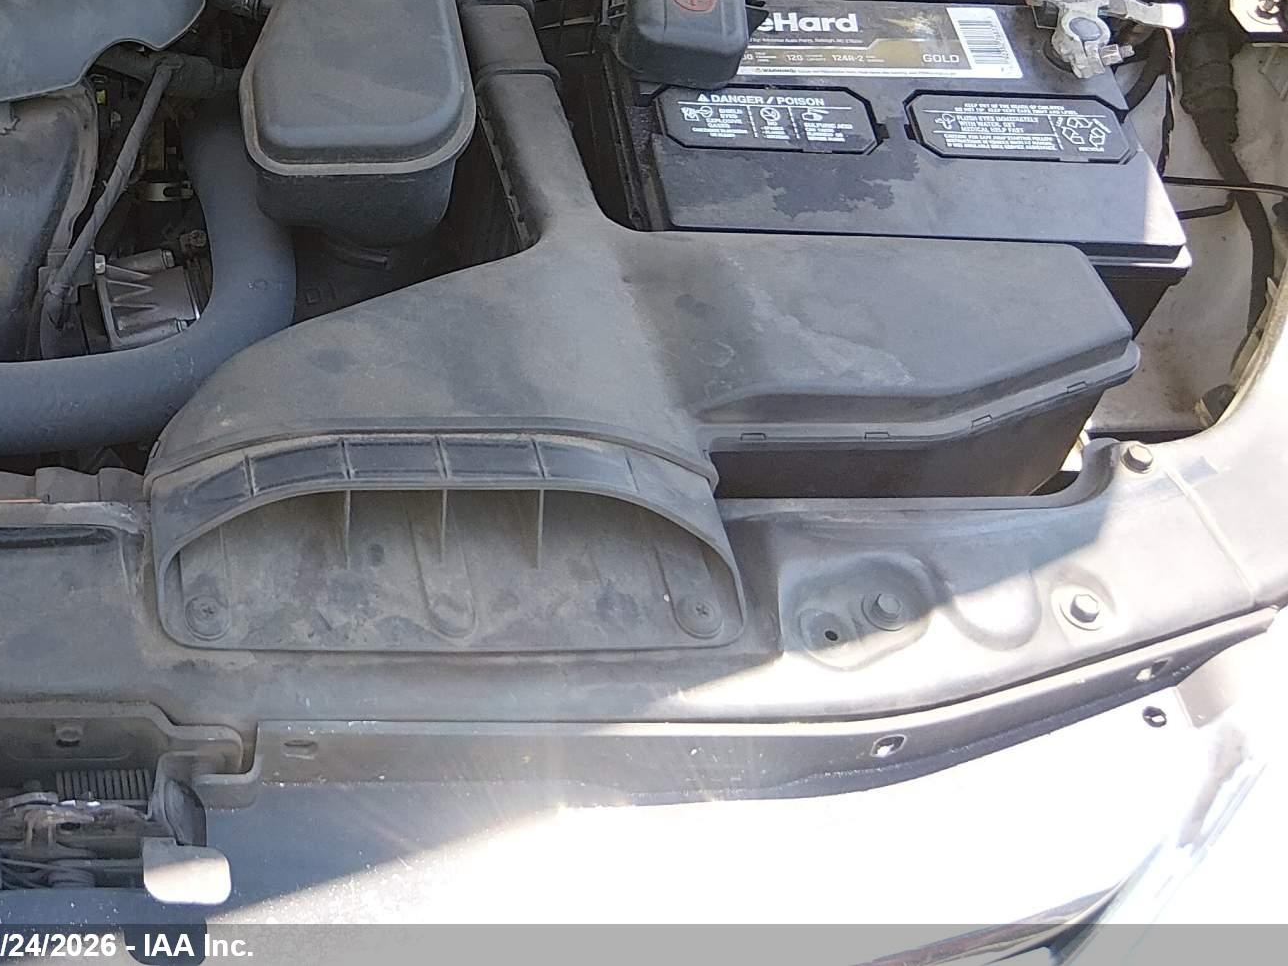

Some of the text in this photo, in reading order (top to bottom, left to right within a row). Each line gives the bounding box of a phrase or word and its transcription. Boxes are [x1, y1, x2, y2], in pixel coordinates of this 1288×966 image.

[922, 54, 960, 63] GOLD
[710, 94, 764, 104] DANGER
[776, 96, 825, 106] POISON
